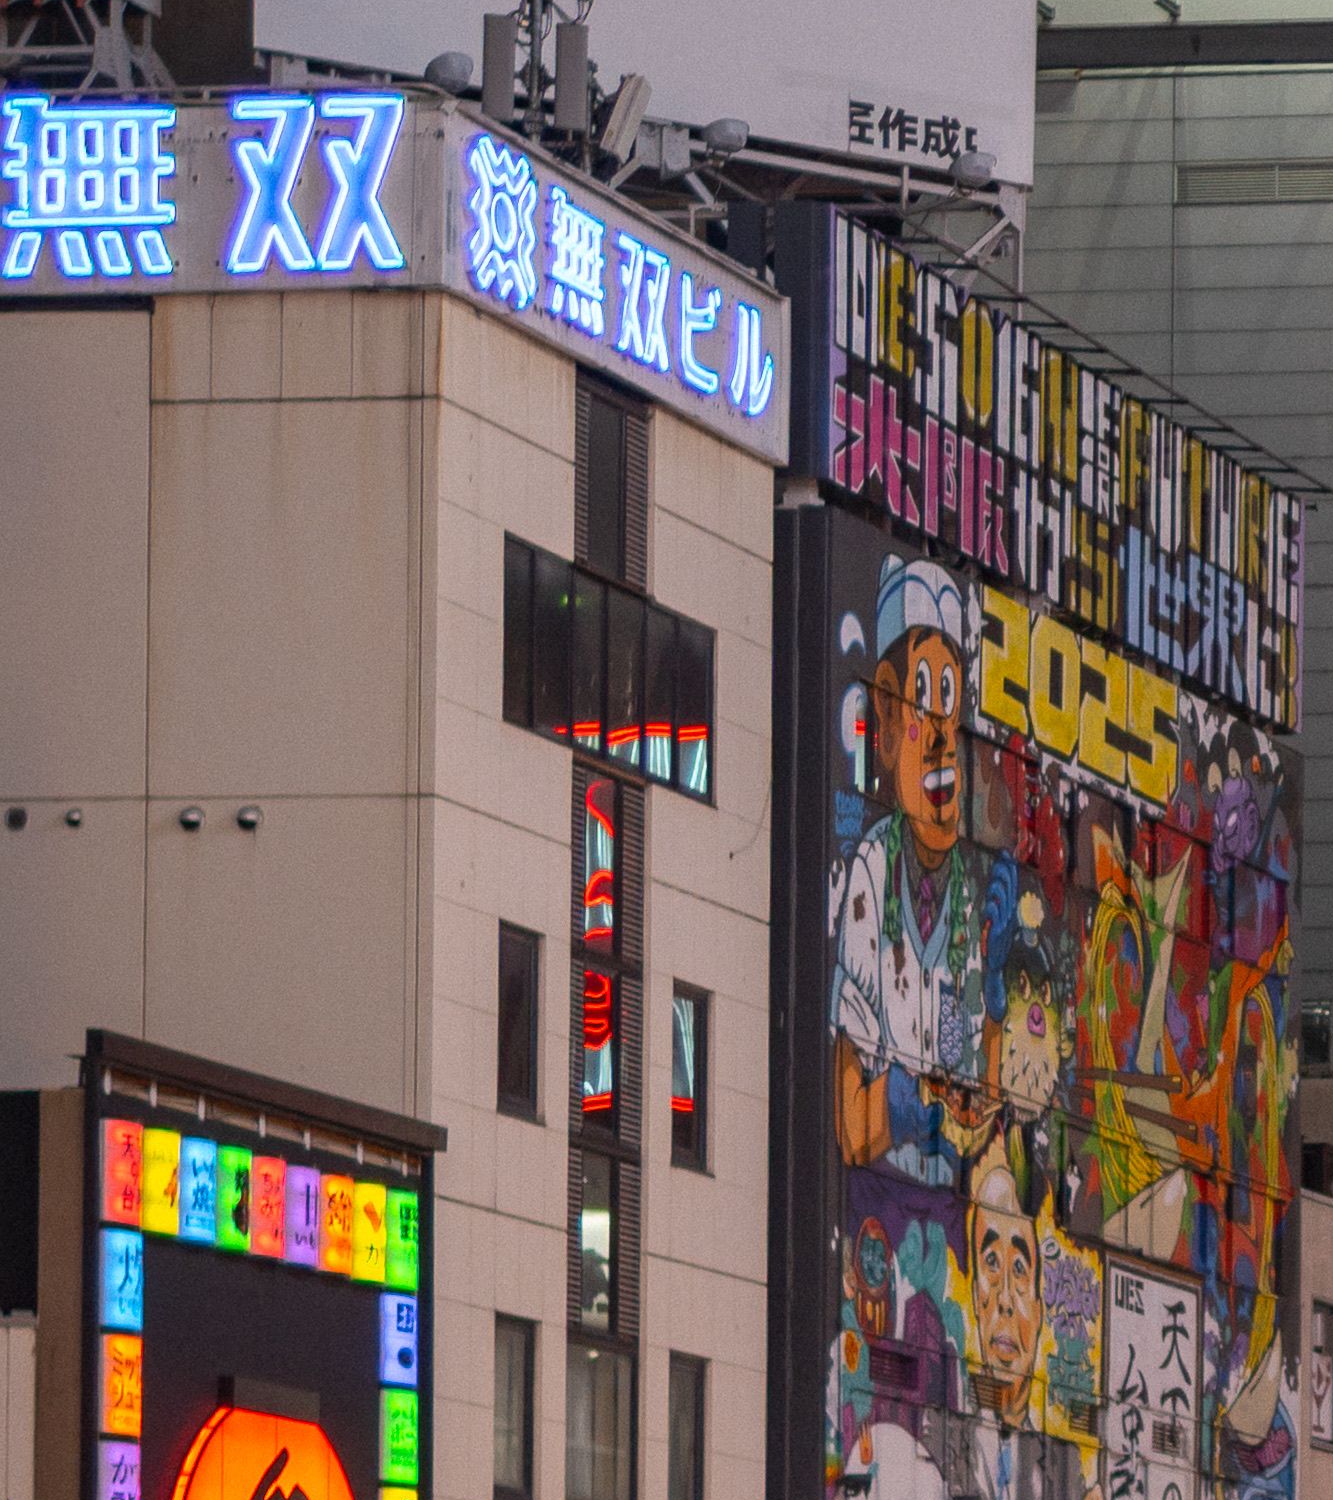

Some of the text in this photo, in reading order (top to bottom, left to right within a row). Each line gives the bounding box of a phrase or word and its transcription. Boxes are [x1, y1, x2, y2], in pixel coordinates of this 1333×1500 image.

[549, 184, 775, 416] 無双ビル
[1120, 395, 1299, 624] FUTURE
[980, 582, 1181, 802] 2025
